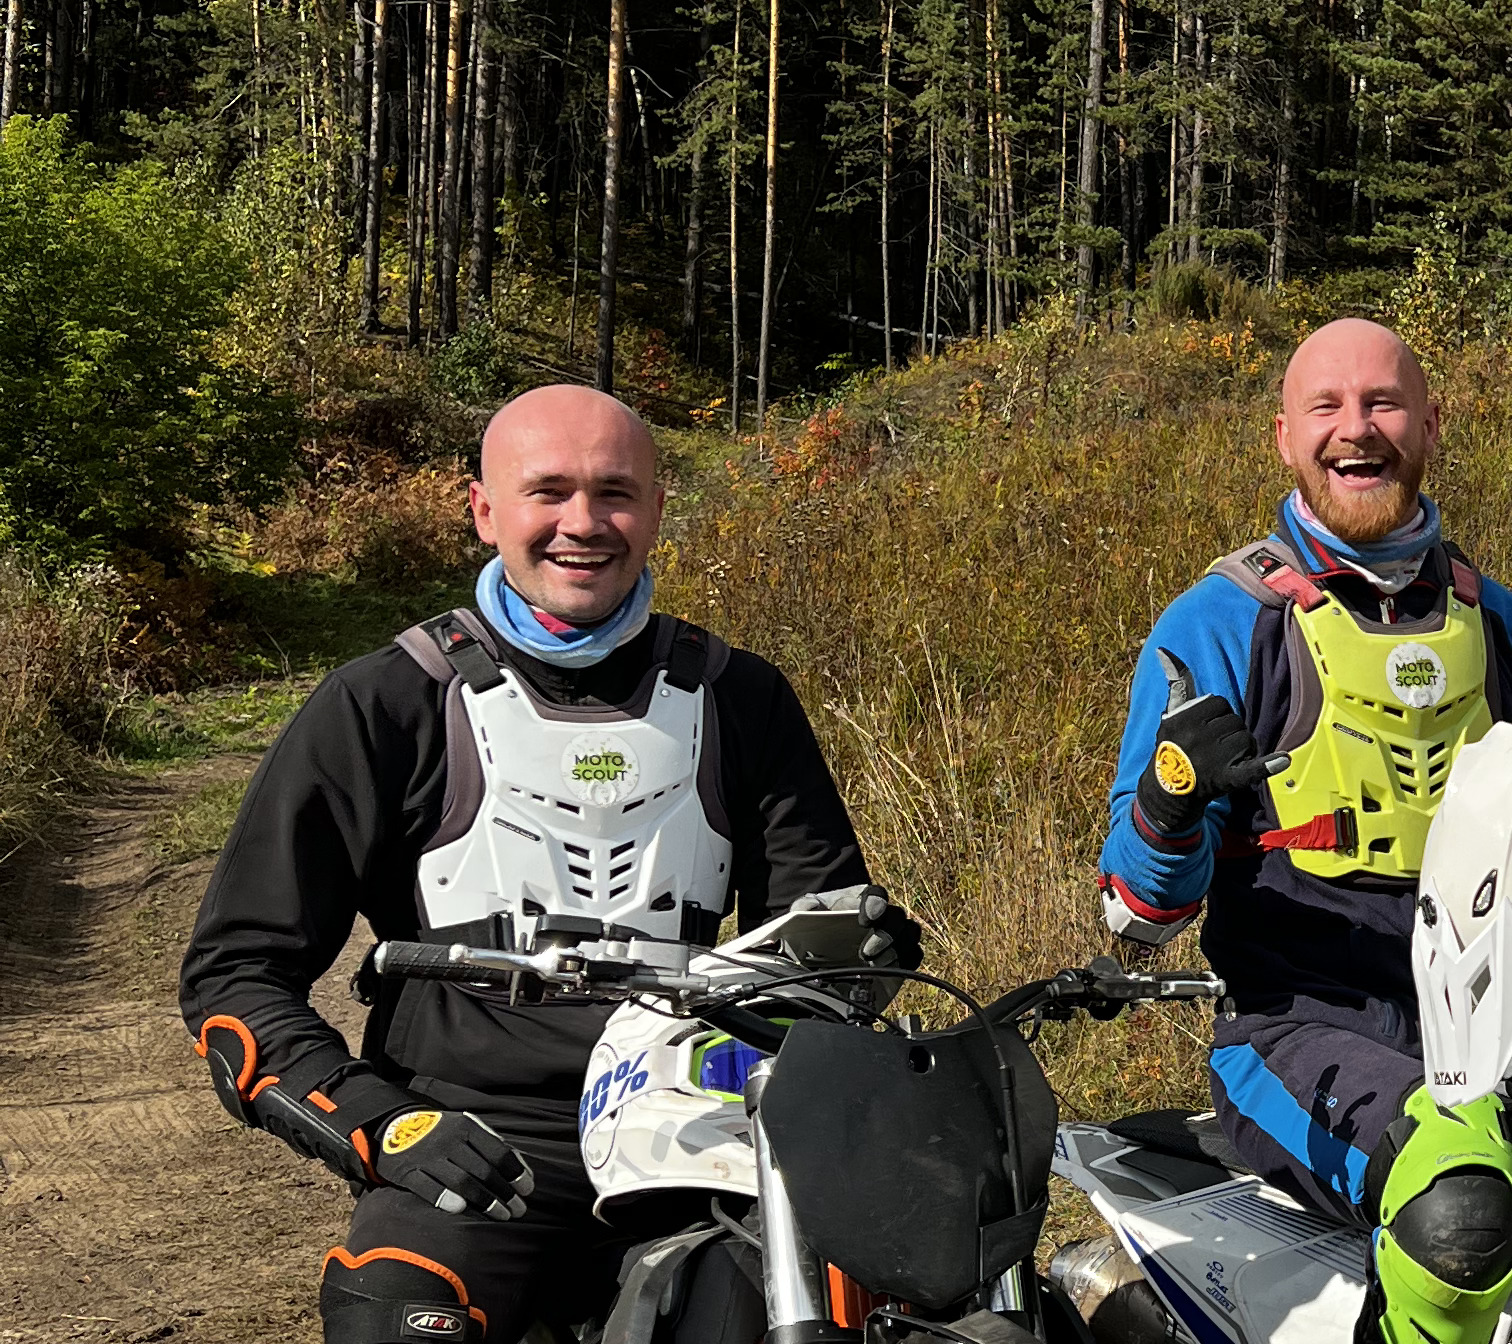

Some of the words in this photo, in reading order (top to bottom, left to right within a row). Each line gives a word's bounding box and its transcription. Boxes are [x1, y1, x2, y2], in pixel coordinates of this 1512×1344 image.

[1395, 661, 1435, 674] MOTO
[1395, 675, 1439, 687] SCOUT
[574, 753, 625, 768] MOTO
[571, 769, 628, 781] SCOUT
